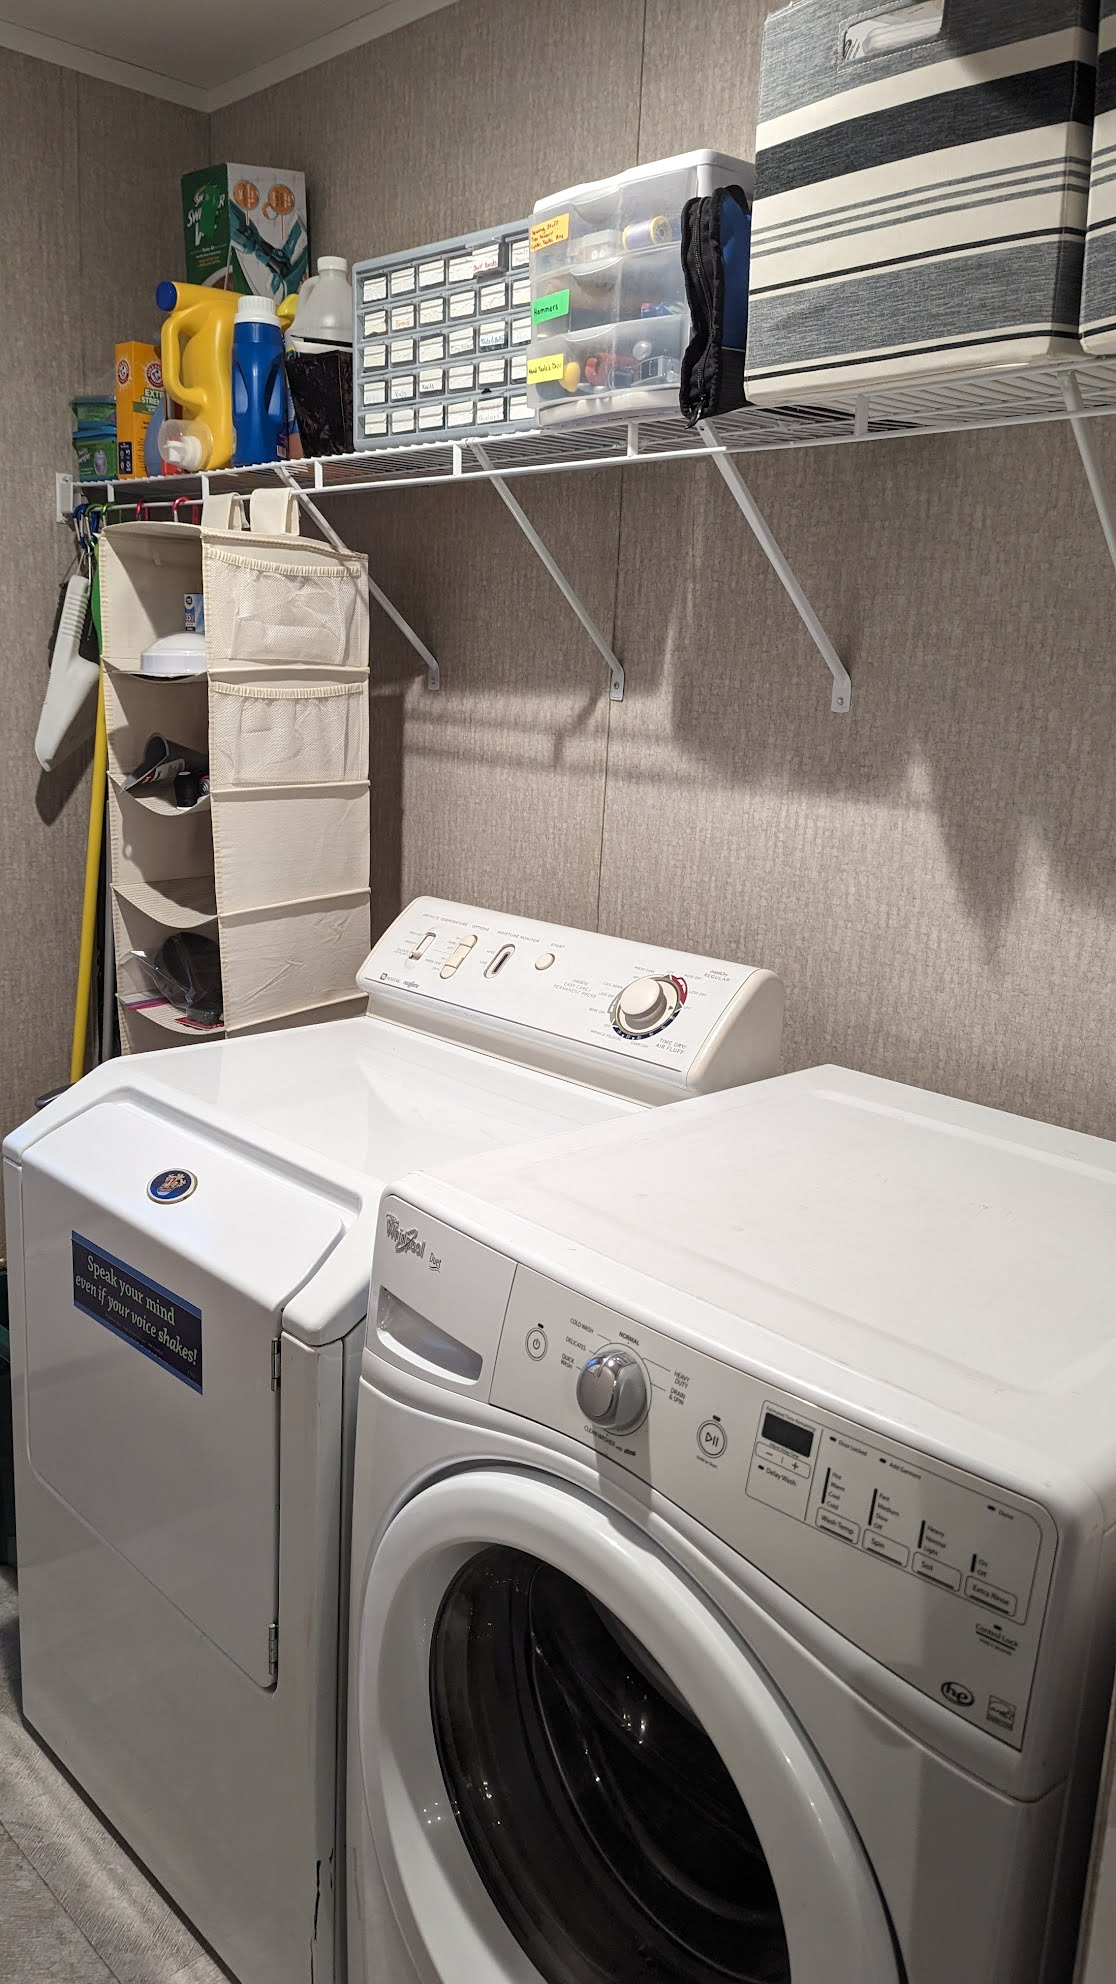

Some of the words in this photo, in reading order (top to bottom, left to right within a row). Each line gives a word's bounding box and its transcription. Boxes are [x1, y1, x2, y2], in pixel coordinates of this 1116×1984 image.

[533, 303, 559, 316] Hammers
[703, 973, 731, 982] REGULAR
[553, 984, 581, 995] PERMANENT
[581, 991, 597, 999] PRESS
[666, 1046, 685, 1054] FLUFF
[386, 1213, 426, 1259] Whirlpool
[87, 1255, 117, 1288] Speak
[119, 1279, 143, 1305] your
[146, 1297, 176, 1326] mind
[75, 1275, 97, 1298] even
[98, 1285, 107, 1306] if
[108, 1296, 130, 1318] your
[131, 1312, 157, 1338] voice
[158, 1327, 197, 1365] shakes!
[569, 1317, 582, 1328] COLD
[581, 1323, 594, 1334] WASH
[565, 1336, 586, 1351] DELICATES
[618, 1331, 640, 1346] NORMAL
[560, 1359, 573, 1369] WASH
[561, 1353, 575, 1364] QUICK
[674, 1370, 690, 1382] HEAVY
[674, 1378, 688, 1389] DUTY
[670, 1387, 686, 1400] DRAIN
[673, 1395, 684, 1405] SPIN
[584, 1425, 597, 1437] CLEAN
[597, 1433, 615, 1447] WASHER
[765, 1467, 781, 1480] Delay
[781, 1475, 797, 1486] Wash
[832, 1472, 842, 1480] Hot
[889, 1462, 899, 1470] Add
[899, 1466, 921, 1480] Garment
[830, 1482, 845, 1491] Warm
[828, 1491, 840, 1500] Cool
[879, 1493, 890, 1501] Fast
[826, 1501, 839, 1510] Cold
[877, 1503, 899, 1516] Medium
[875, 1512, 888, 1522] Slow
[821, 1514, 837, 1526] Wash
[837, 1522, 854, 1535] Temp
[873, 1522, 882, 1530] Off
[927, 1525, 945, 1538] Heavy
[871, 1538, 885, 1549] Spin
[925, 1535, 946, 1548] Normal
[923, 1545, 938, 1556] Light
[921, 1560, 933, 1571] Soil
[978, 1559, 988, 1567] On
[976, 1569, 987, 1577] Off
[972, 1584, 989, 1598] Extra
[990, 1593, 1009, 1605] Rinse
[975, 1623, 1001, 1640] Control
[1001, 1634, 1018, 1647] Lock
[945, 1682, 968, 1701] he
